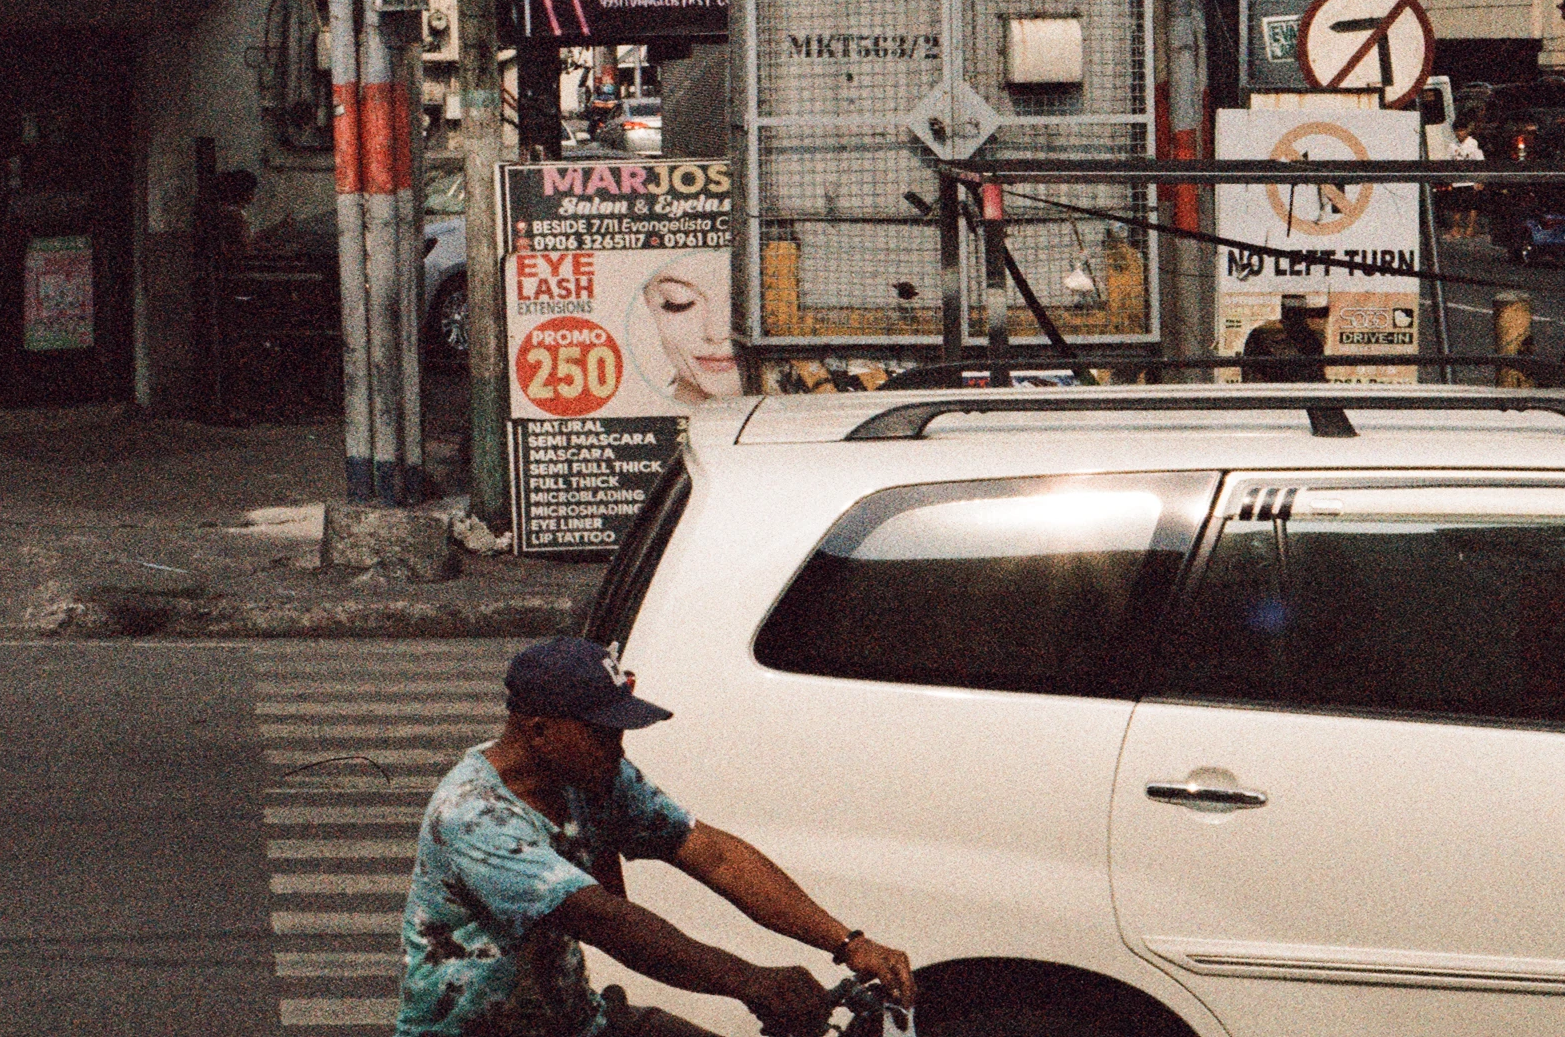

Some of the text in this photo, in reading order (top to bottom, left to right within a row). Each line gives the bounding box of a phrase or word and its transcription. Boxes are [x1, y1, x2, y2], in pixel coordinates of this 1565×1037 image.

[542, 164, 731, 196] MARJOS
[558, 196, 629, 216] Salon
[533, 219, 587, 234] BESIDE
[621, 217, 712, 234] Evangelista
[533, 235, 578, 250] 0906
[516, 253, 595, 278] EYE
[1227, 249, 1415, 276] NO LEFT TURN
[516, 277, 595, 301] LASH
[517, 299, 593, 315] EXTENSIONS
[531, 328, 607, 347] PROMO
[1343, 333, 1410, 344] DRIVE-IN
[526, 346, 615, 399] 250
[528, 421, 605, 433] NATURAL
[528, 435, 567, 447] SEMI
[571, 433, 657, 446] MASCARA
[530, 448, 616, 461] MASCARA
[530, 460, 663, 475] SEMI FULL THICK
[530, 475, 620, 489] FULL THICK
[530, 489, 645, 503] MICROBLADING
[531, 517, 603, 531] EYE LINER
[532, 531, 616, 544] LIP TATTOO
